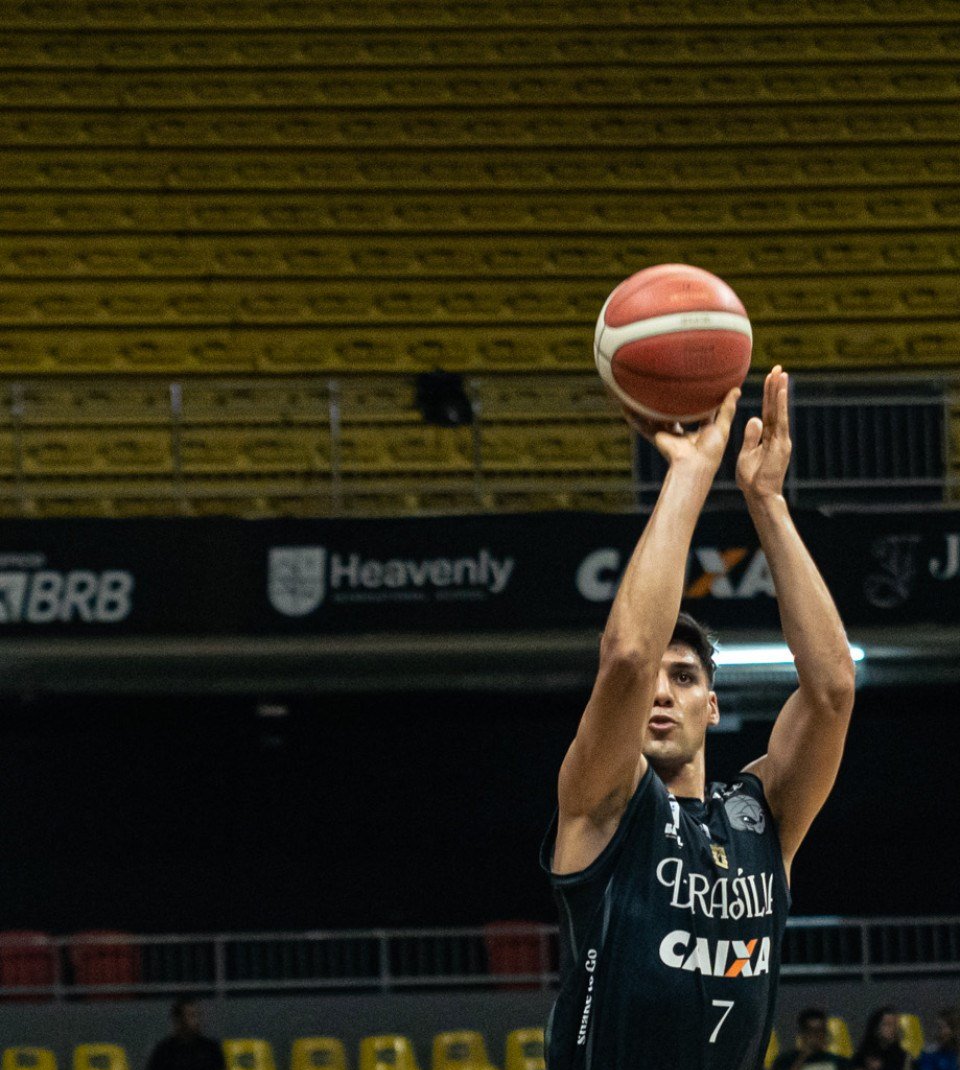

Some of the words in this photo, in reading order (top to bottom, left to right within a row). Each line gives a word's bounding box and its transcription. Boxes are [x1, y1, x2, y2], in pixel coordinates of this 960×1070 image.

[27, 569, 134, 622] BRB
[330, 551, 515, 594] Heavenly
[576, 548, 777, 601] CXA
[659, 929, 771, 978] CAIXA
[709, 999, 735, 1043] 7
